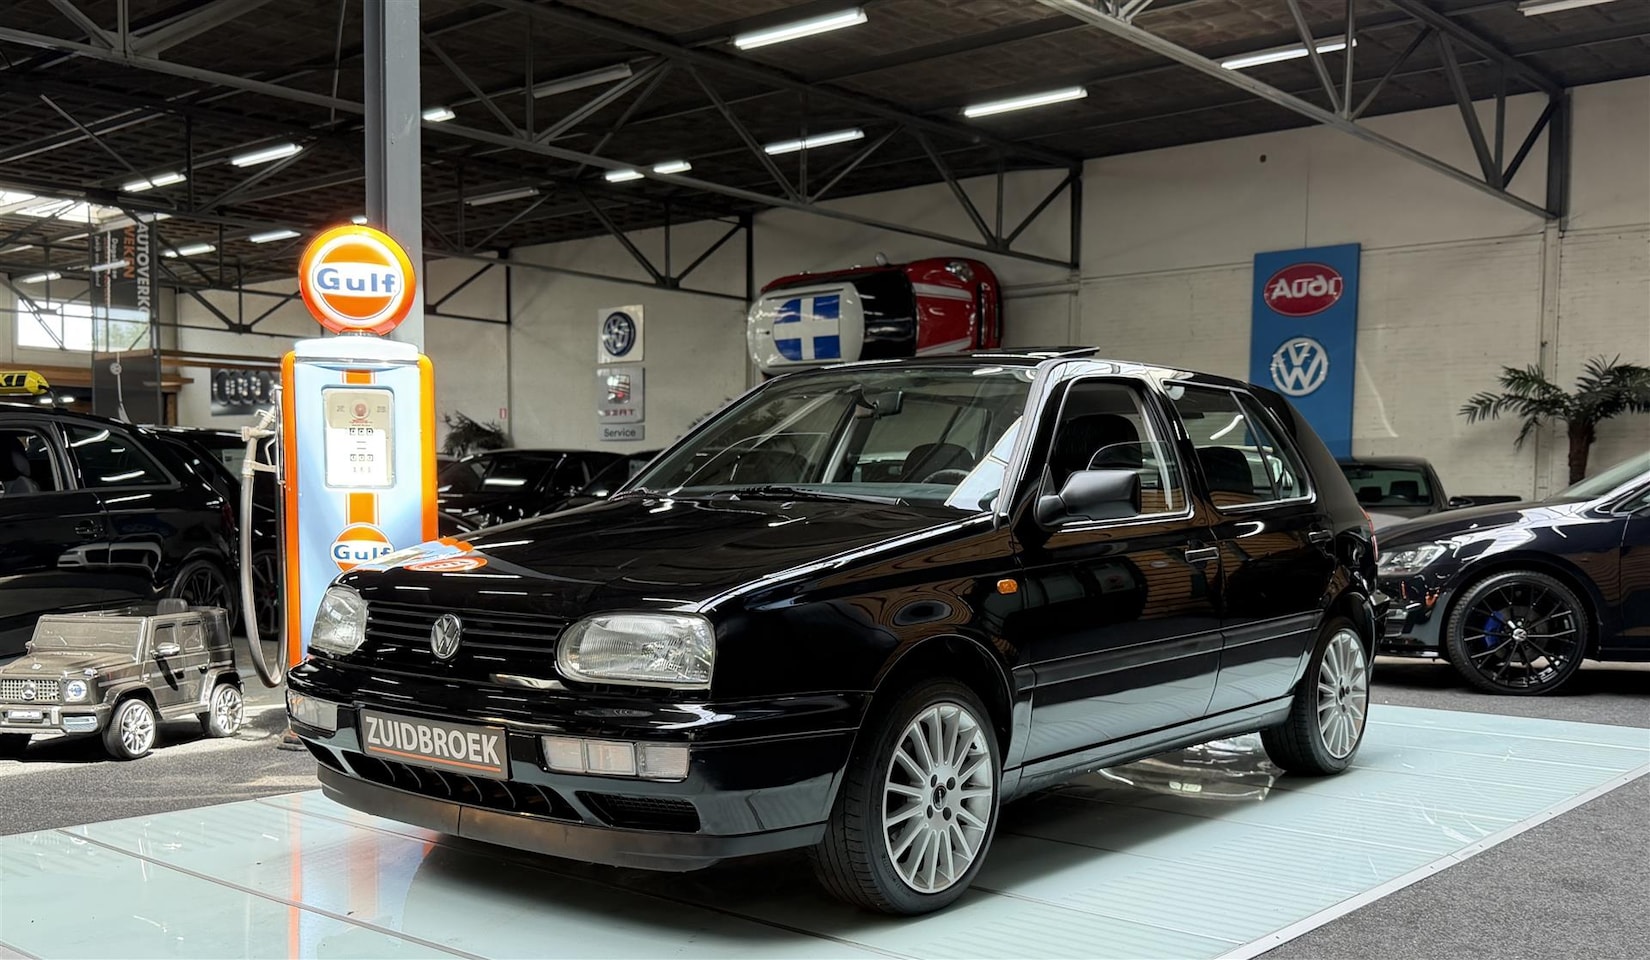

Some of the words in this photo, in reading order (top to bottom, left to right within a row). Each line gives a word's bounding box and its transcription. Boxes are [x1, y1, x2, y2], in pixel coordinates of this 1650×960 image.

[317, 268, 395, 293] Gulf
[604, 428, 636, 437] Service
[334, 544, 391, 561] Gulf
[366, 716, 501, 765] ZUIDBROEK
